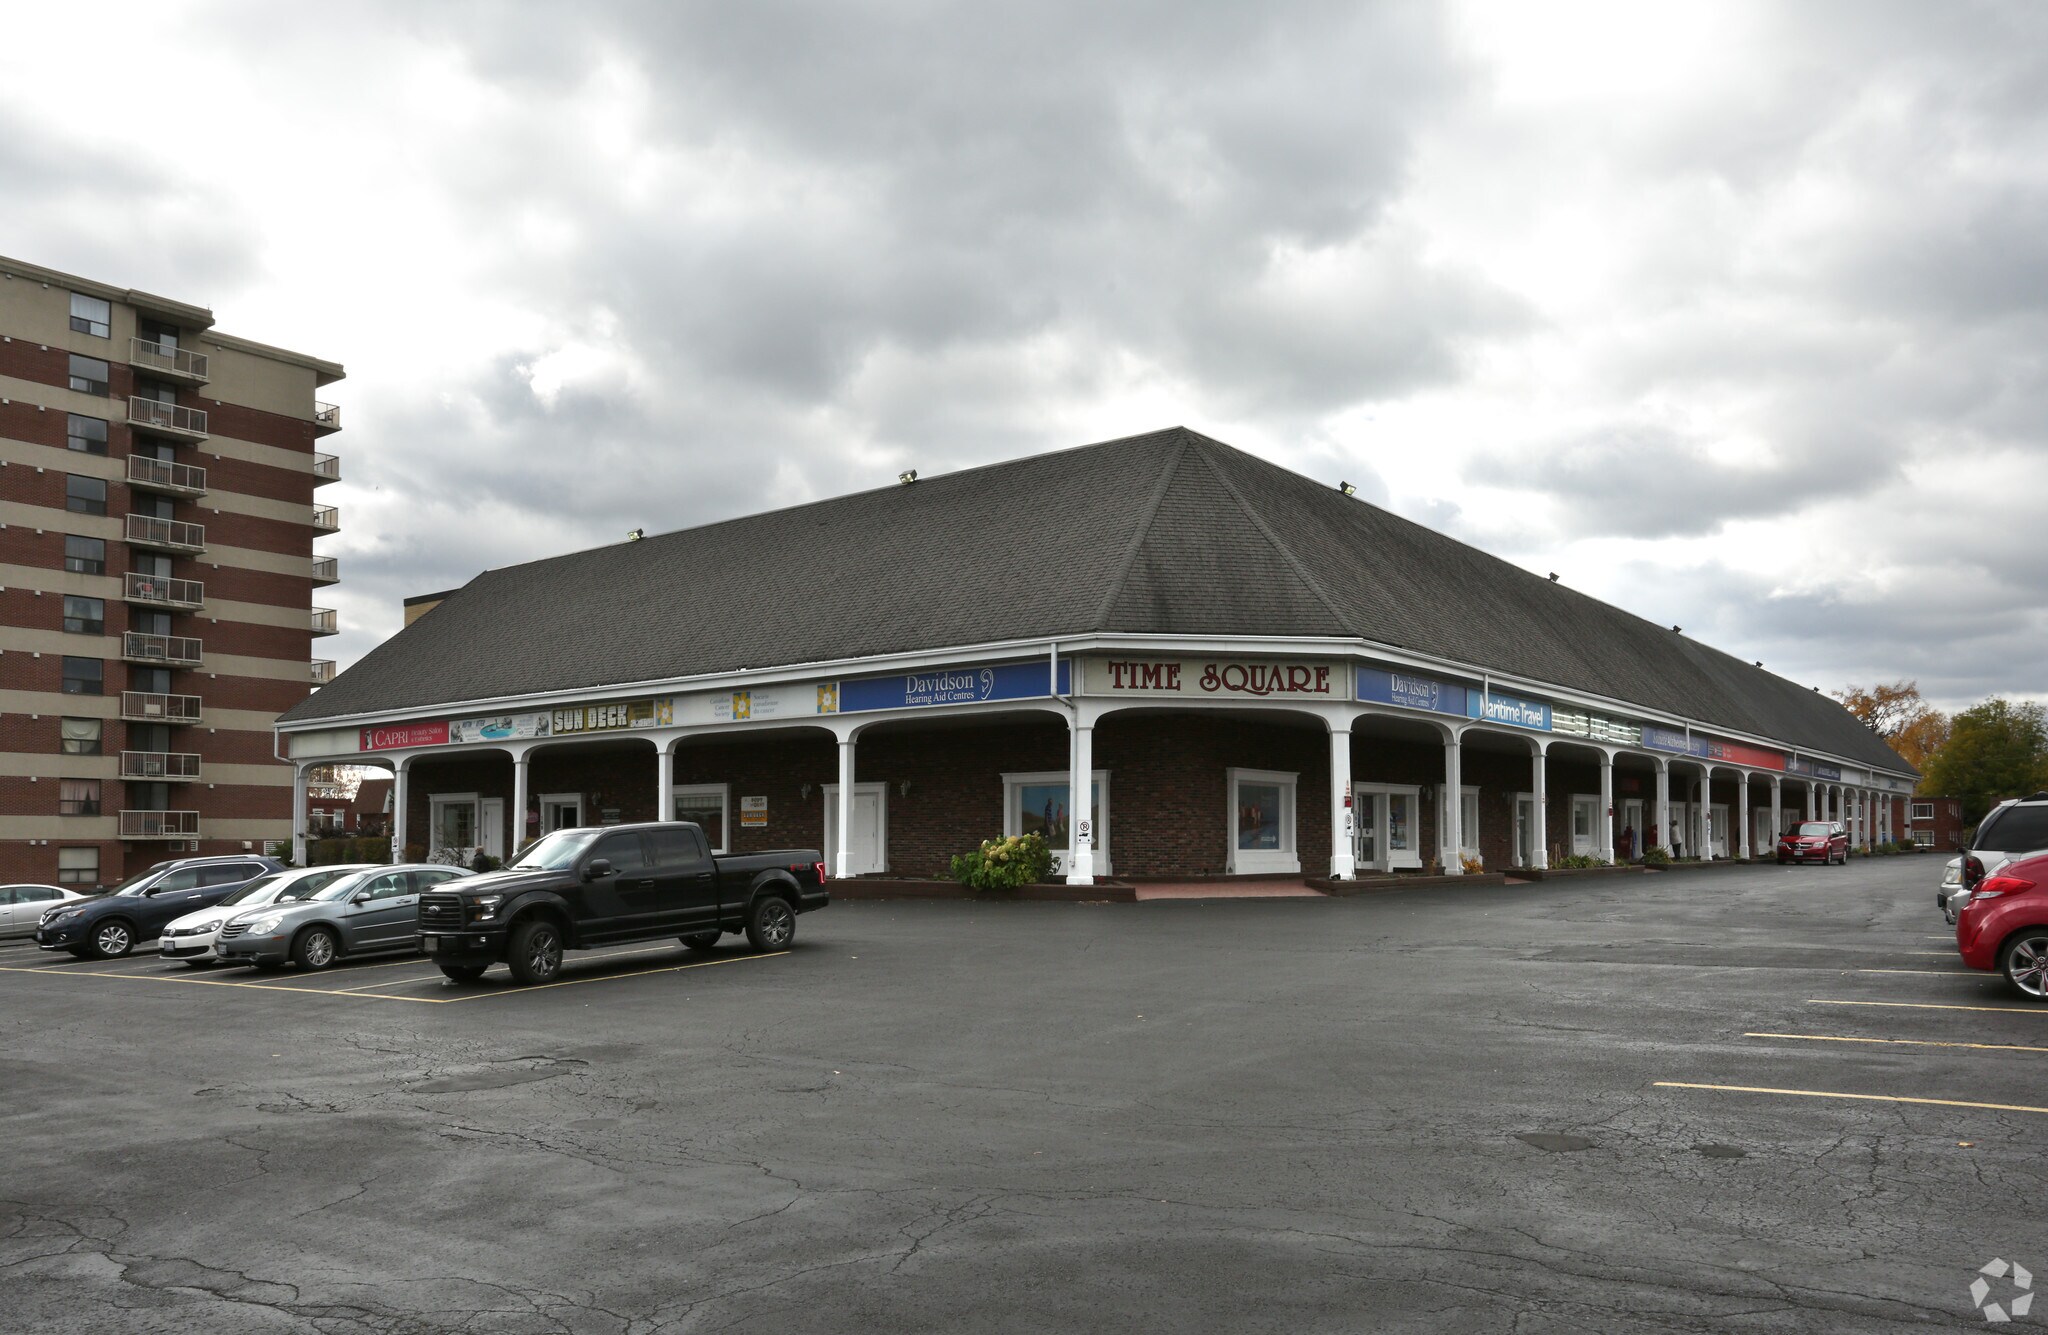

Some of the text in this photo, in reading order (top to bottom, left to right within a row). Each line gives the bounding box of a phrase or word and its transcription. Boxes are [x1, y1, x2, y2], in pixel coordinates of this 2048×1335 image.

[905, 672, 974, 694] Davidson
[1108, 661, 1330, 695] TIME SQUARE
[1391, 673, 1429, 697] Davidson
[905, 691, 975, 704] Hearing Aid Centres
[554, 708, 583, 732] SUN
[587, 704, 628, 729] DECK
[1479, 694, 1543, 727] Maritime Travel
[375, 730, 408, 746] CAPRI
[428, 727, 443, 735] Salon
